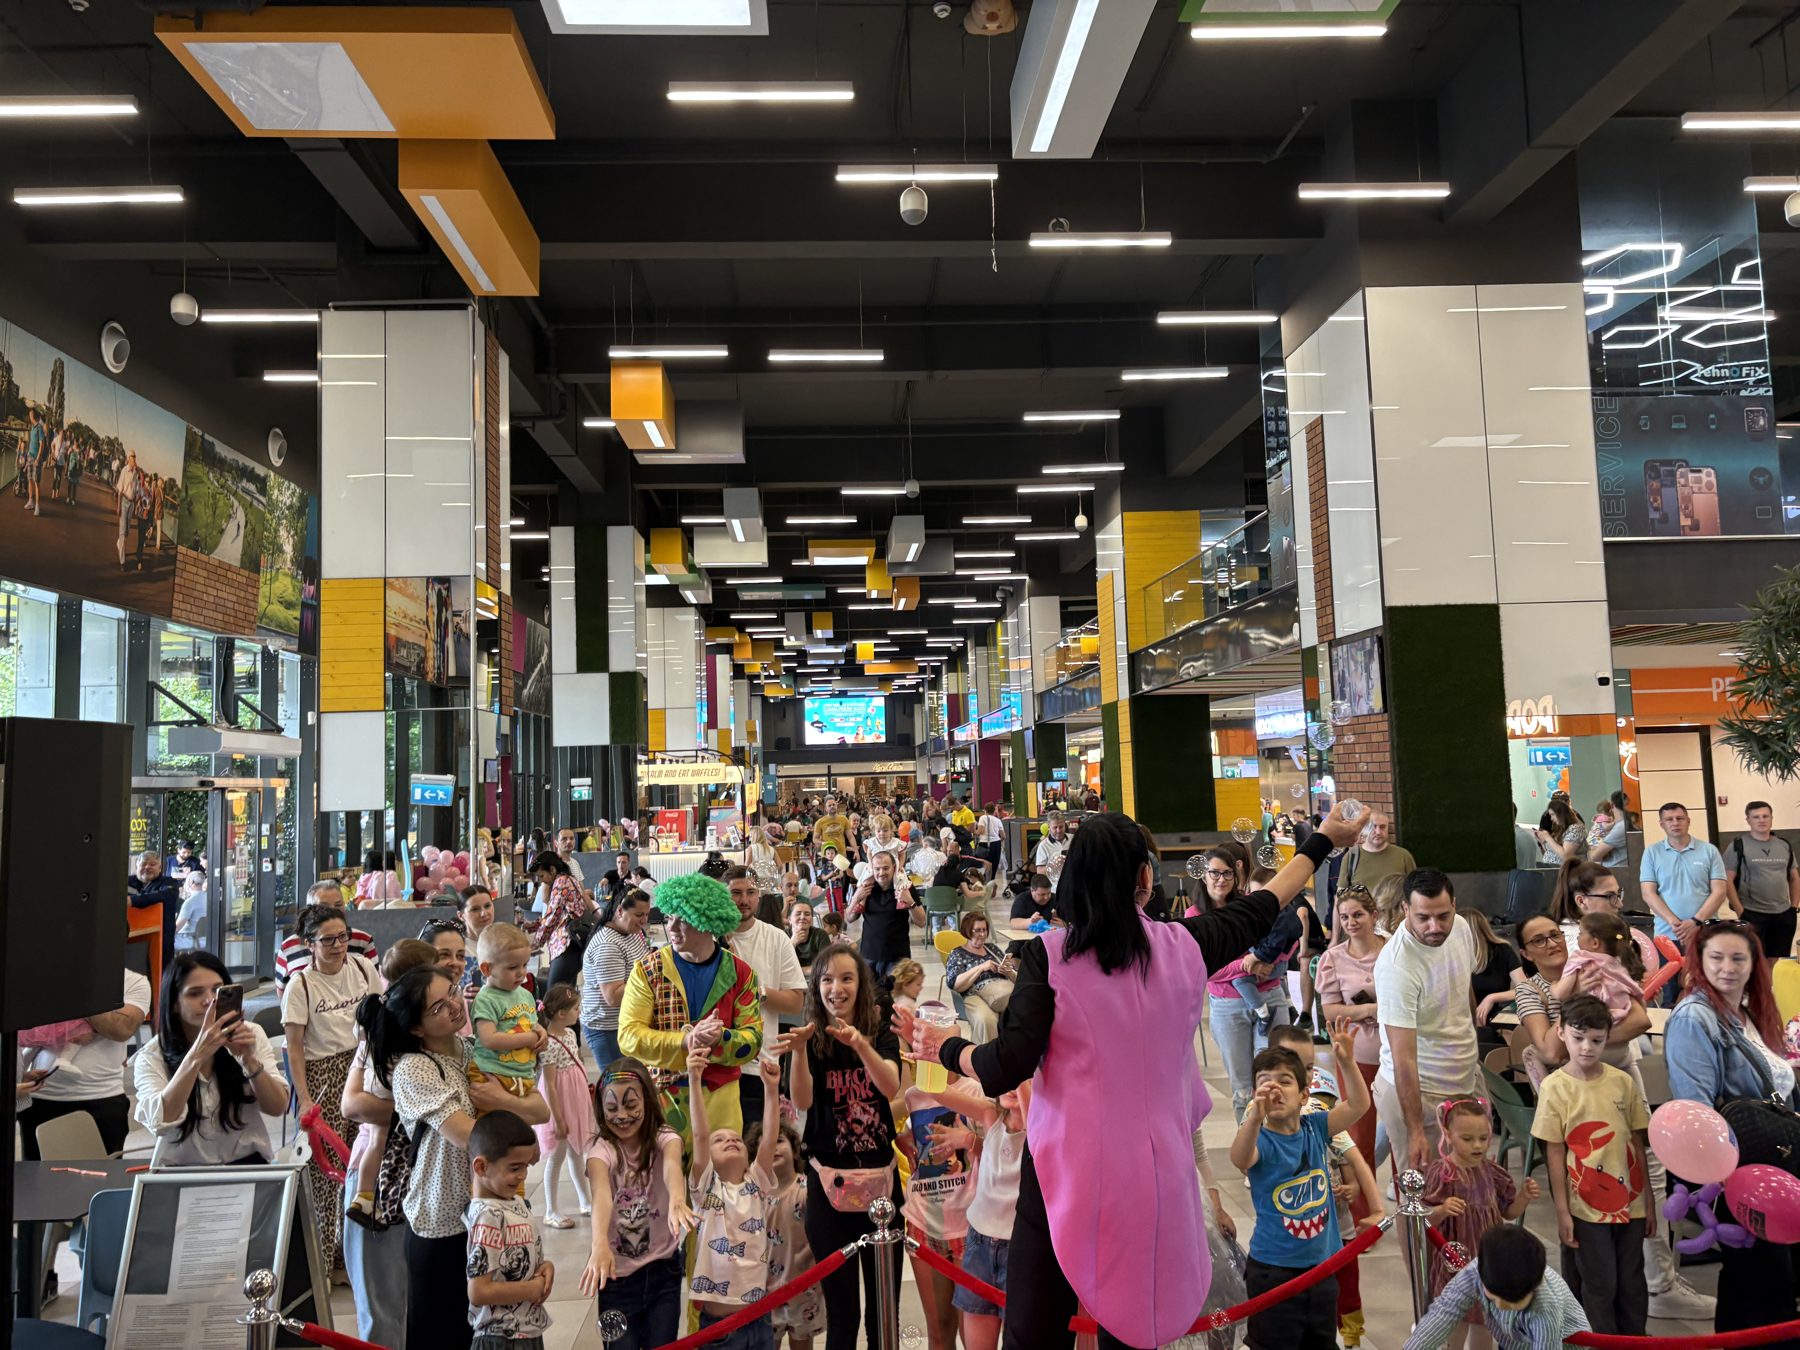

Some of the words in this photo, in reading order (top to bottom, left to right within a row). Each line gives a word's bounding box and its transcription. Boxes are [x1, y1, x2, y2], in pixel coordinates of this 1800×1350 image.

[1592, 396, 1629, 537] SERVICE
[664, 769, 678, 778] AND
[678, 768, 691, 777] EAT
[691, 767, 722, 777] WAFFLES!
[924, 1181, 937, 1191] AND
[938, 1175, 966, 1189] STITCH
